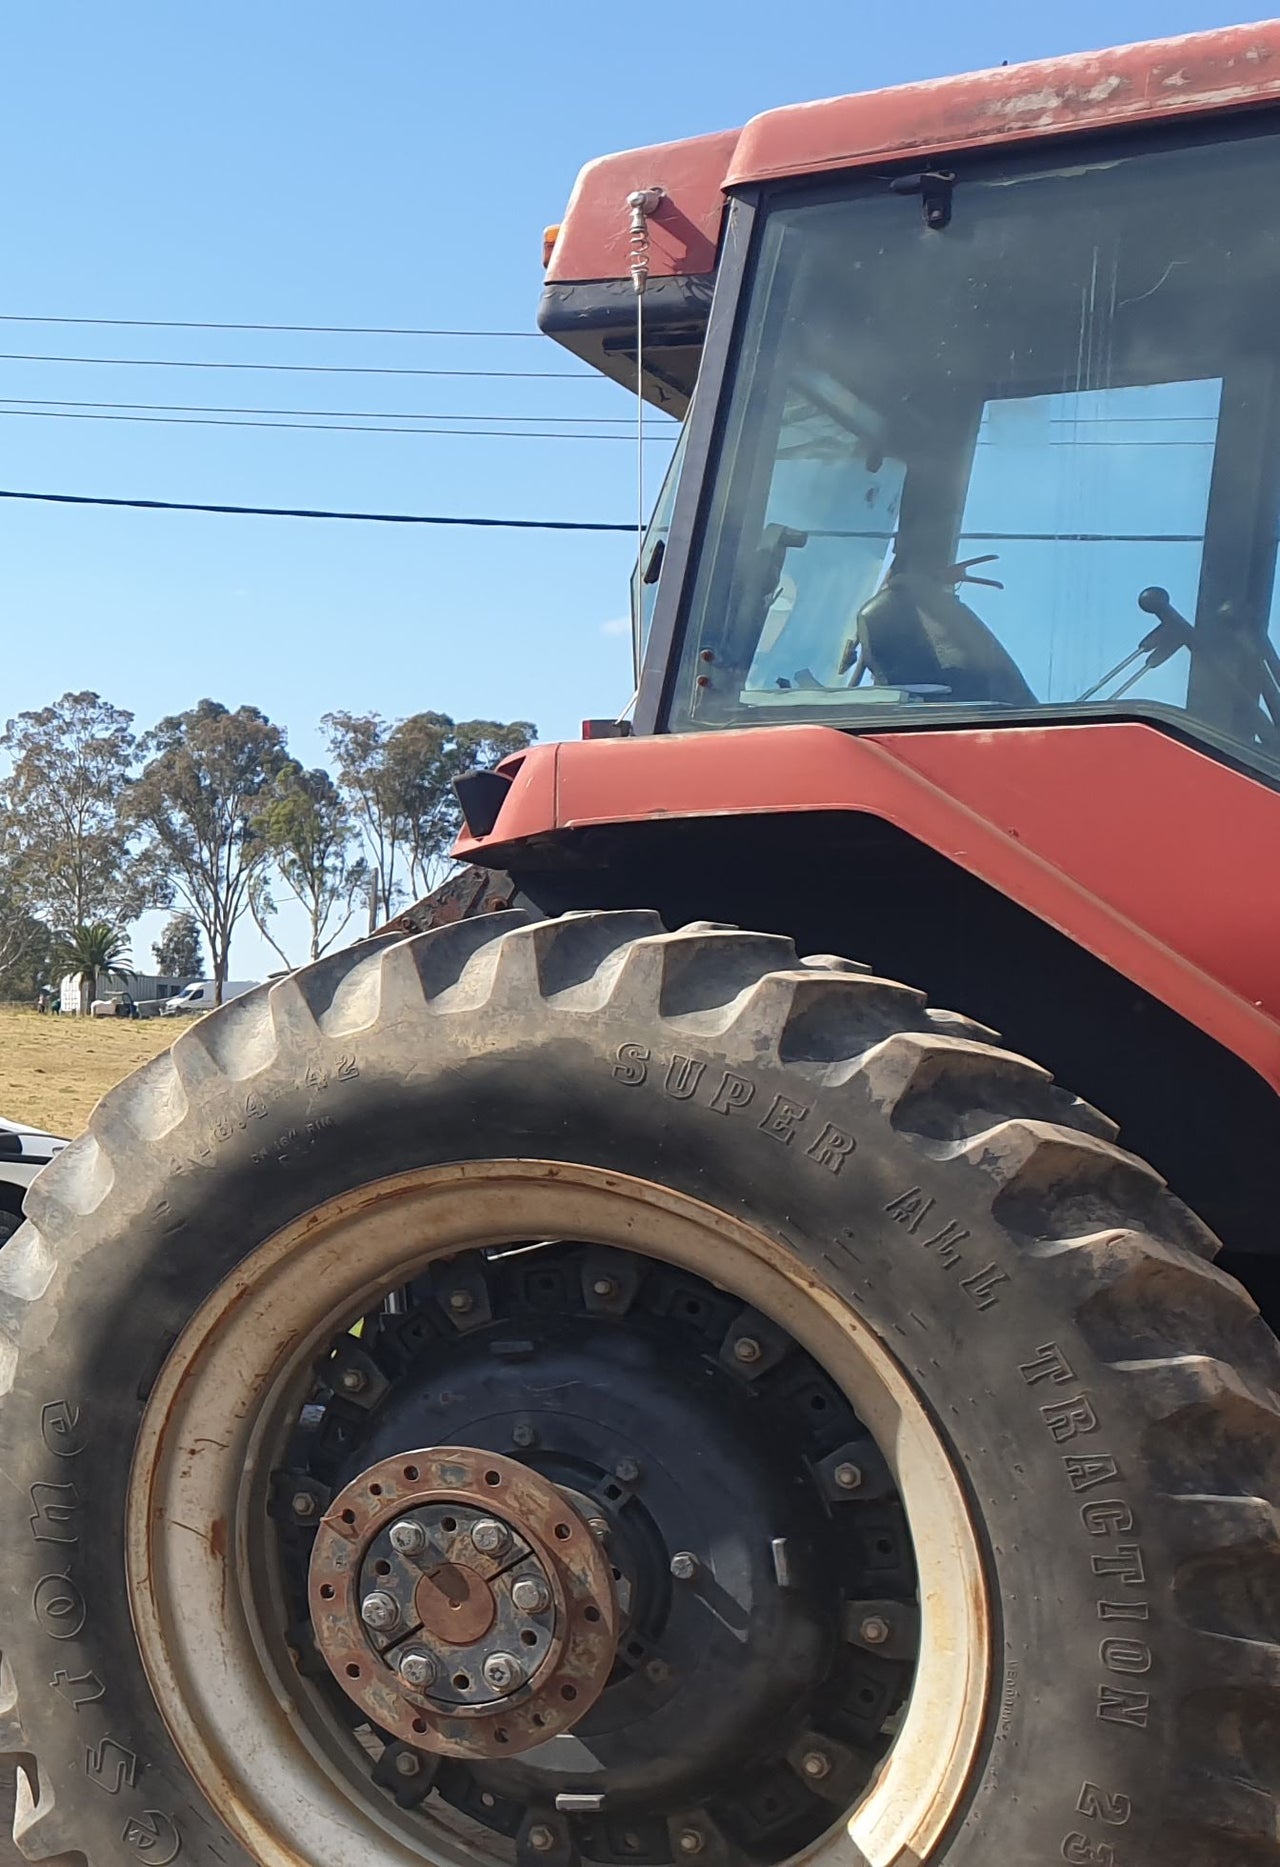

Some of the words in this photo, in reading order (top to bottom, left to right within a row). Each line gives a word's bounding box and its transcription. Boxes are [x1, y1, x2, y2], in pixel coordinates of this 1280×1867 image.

[614, 1041, 858, 1174] SUPER
[883, 1185, 1014, 1314] ALL
[1017, 1340, 1153, 1730] TRACTION
